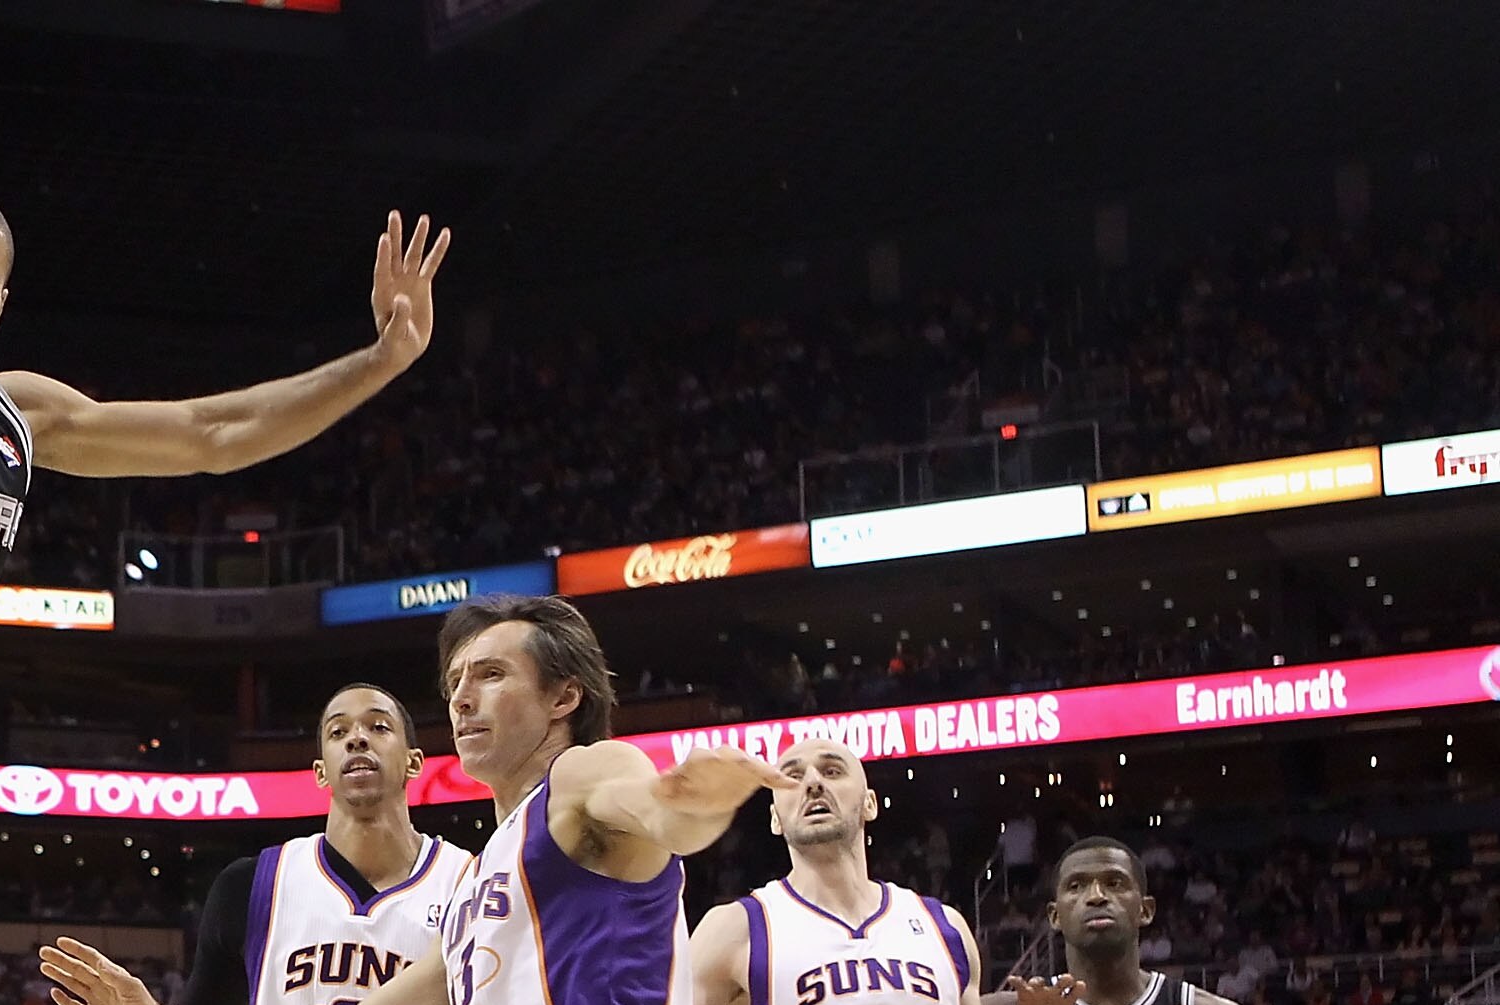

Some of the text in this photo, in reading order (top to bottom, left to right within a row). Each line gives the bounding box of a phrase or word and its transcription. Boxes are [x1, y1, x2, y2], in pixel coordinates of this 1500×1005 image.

[400, 579, 467, 609] DASANI
[1175, 668, 1347, 725] Earnhardt
[914, 693, 1060, 754] DEALERS
[66, 773, 260, 817] TOYOTA
[284, 942, 414, 995] SUN
